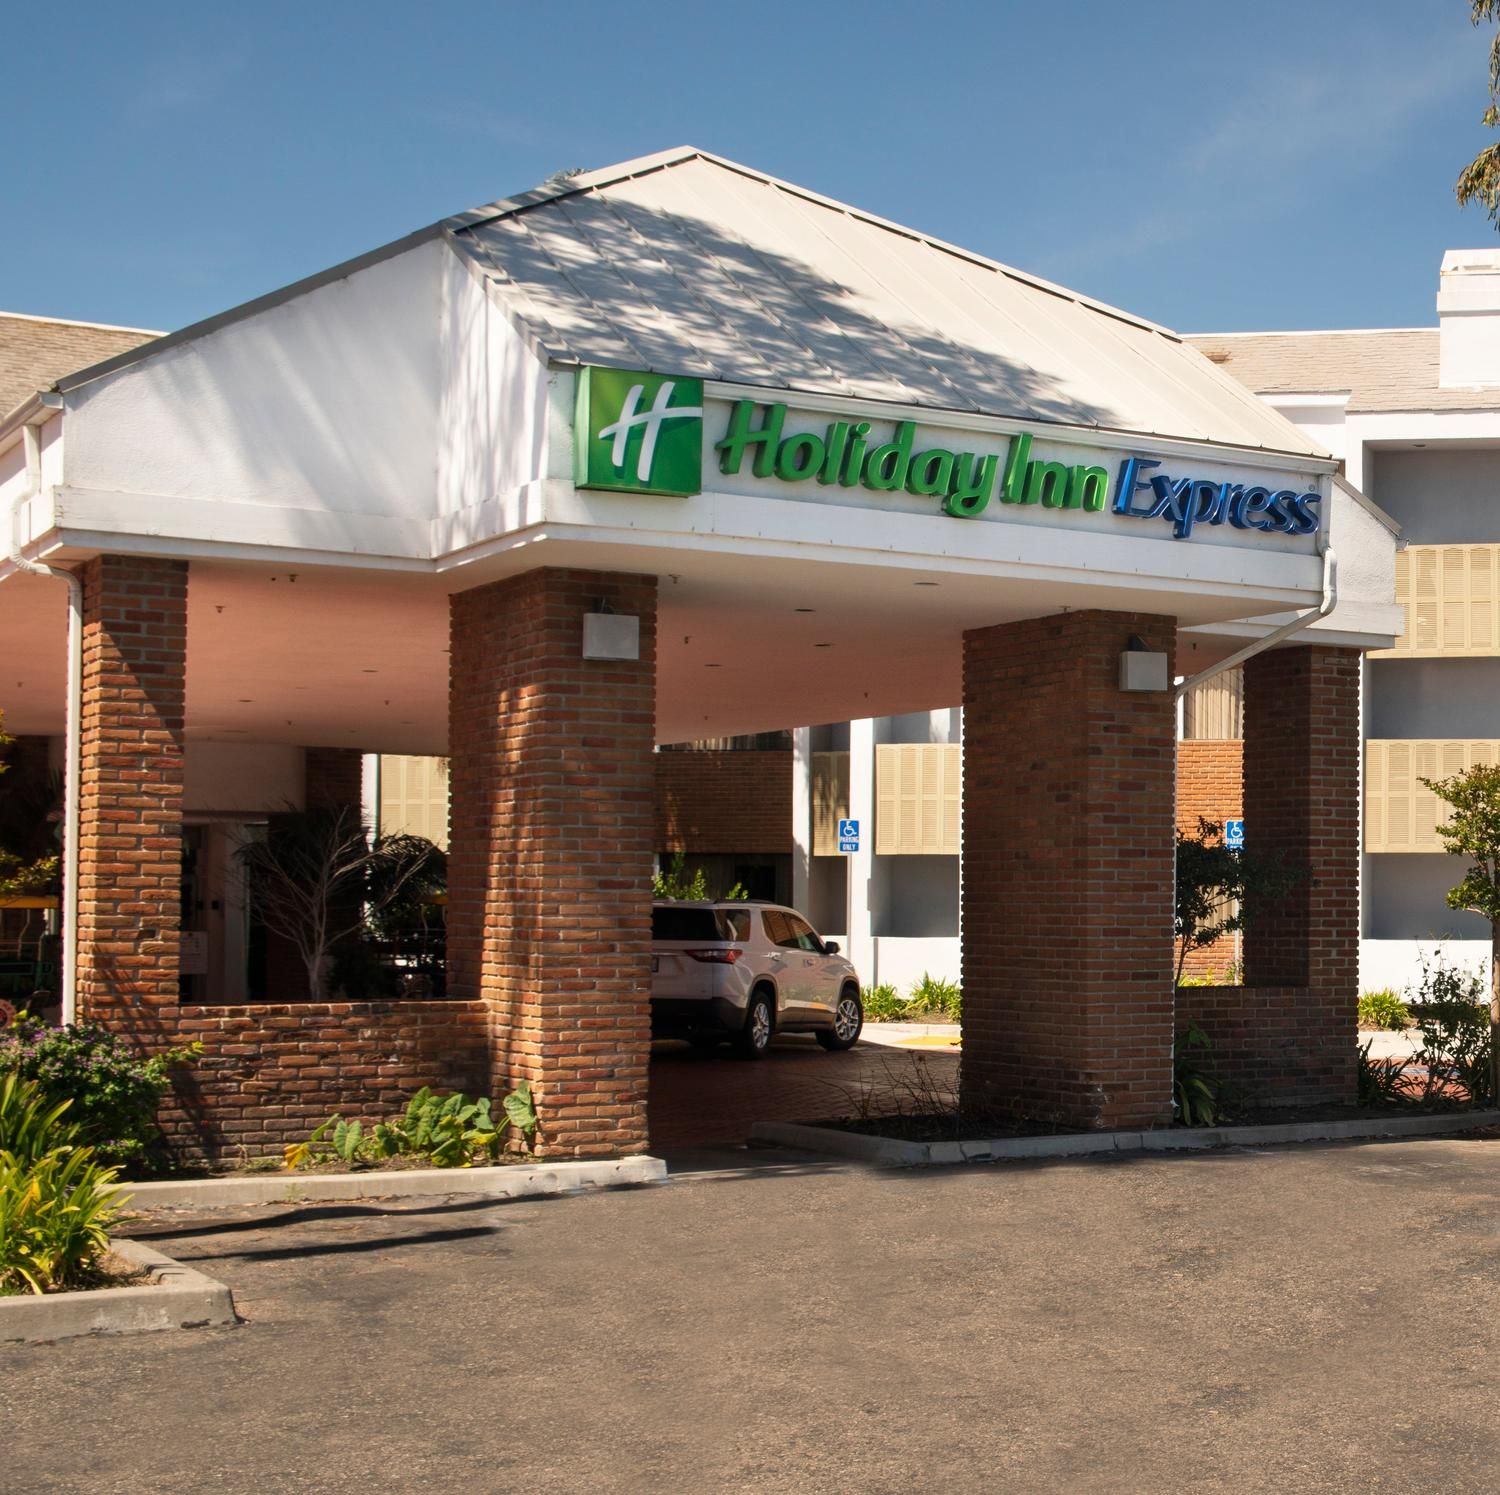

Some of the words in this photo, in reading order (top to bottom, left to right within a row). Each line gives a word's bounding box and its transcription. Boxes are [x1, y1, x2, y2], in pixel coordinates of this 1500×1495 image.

[715, 398, 999, 518] Holiday
[1000, 431, 1109, 513] Inn
[1112, 457, 1321, 539] Express
[842, 843, 856, 851] ONLY
